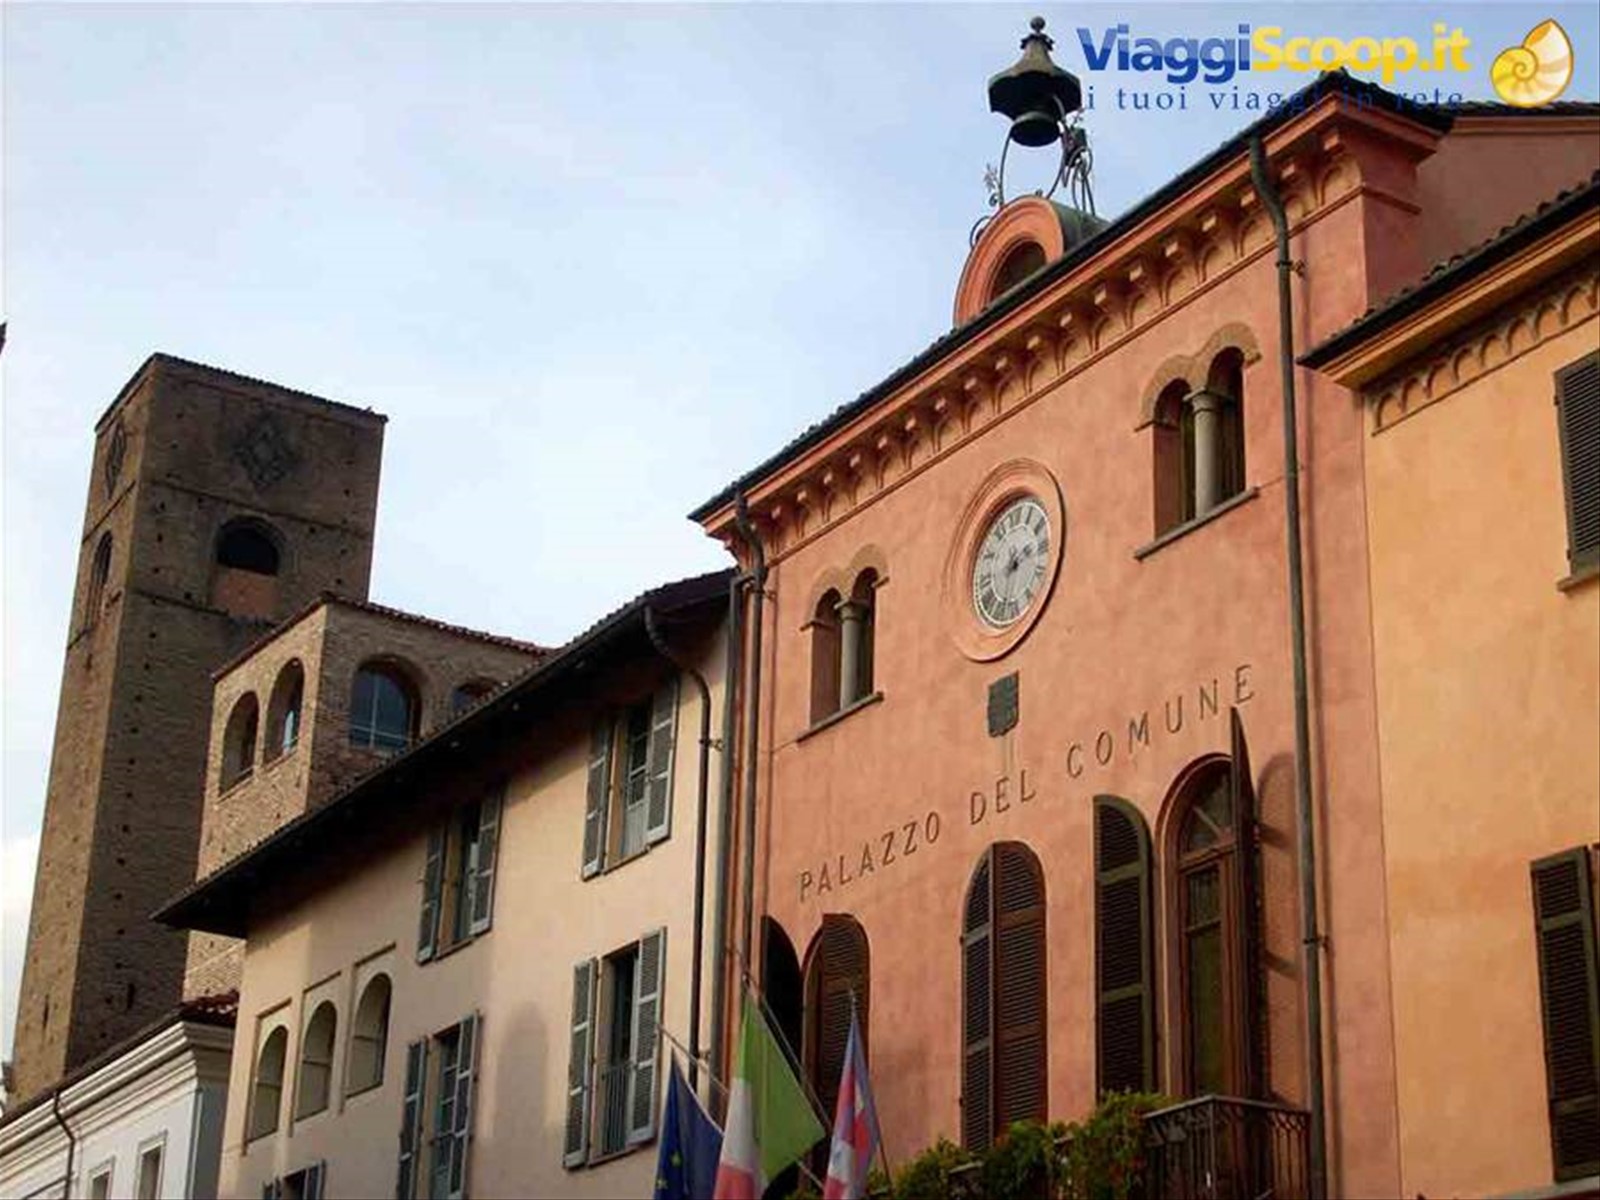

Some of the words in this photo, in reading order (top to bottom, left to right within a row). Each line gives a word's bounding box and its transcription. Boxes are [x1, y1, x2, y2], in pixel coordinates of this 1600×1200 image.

[799, 811, 941, 903] PALAZZO
[970, 769, 1036, 825] DEL
[1066, 664, 1254, 778] COMUNE
